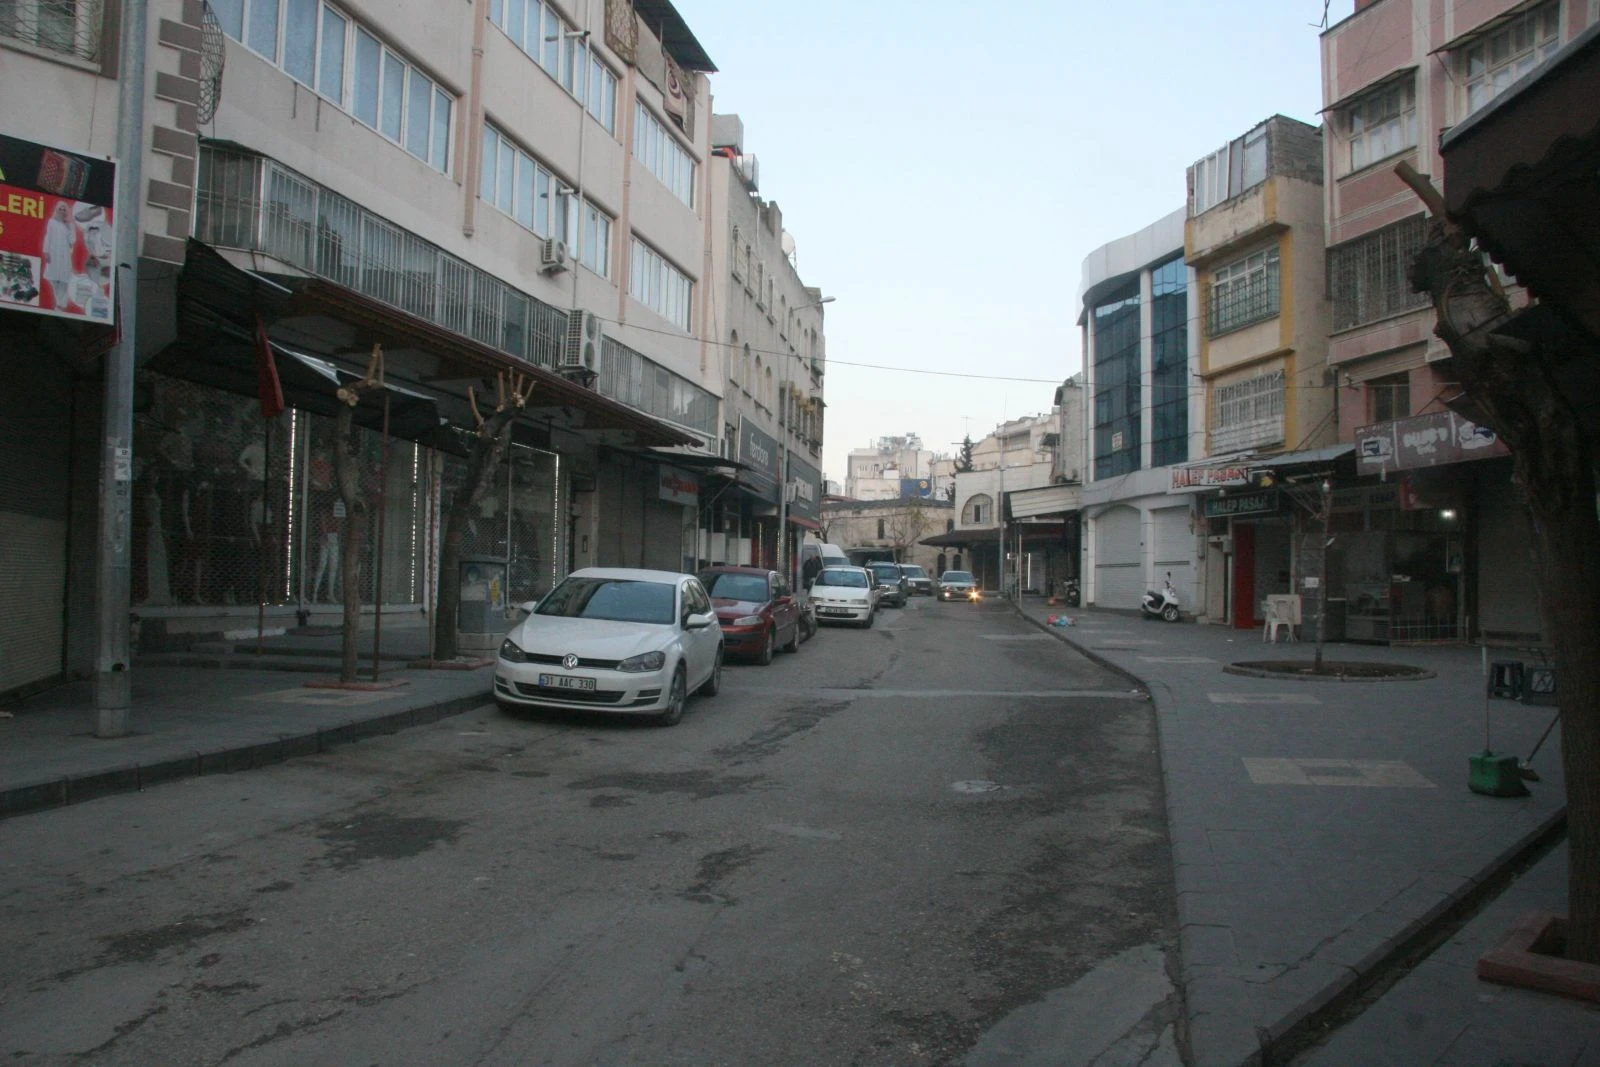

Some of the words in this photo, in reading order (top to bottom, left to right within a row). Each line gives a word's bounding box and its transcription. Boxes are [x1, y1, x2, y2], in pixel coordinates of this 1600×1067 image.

[1172, 466, 1204, 489] HALEP
[1212, 499, 1238, 515] HALEP
[579, 680, 593, 689] 330
